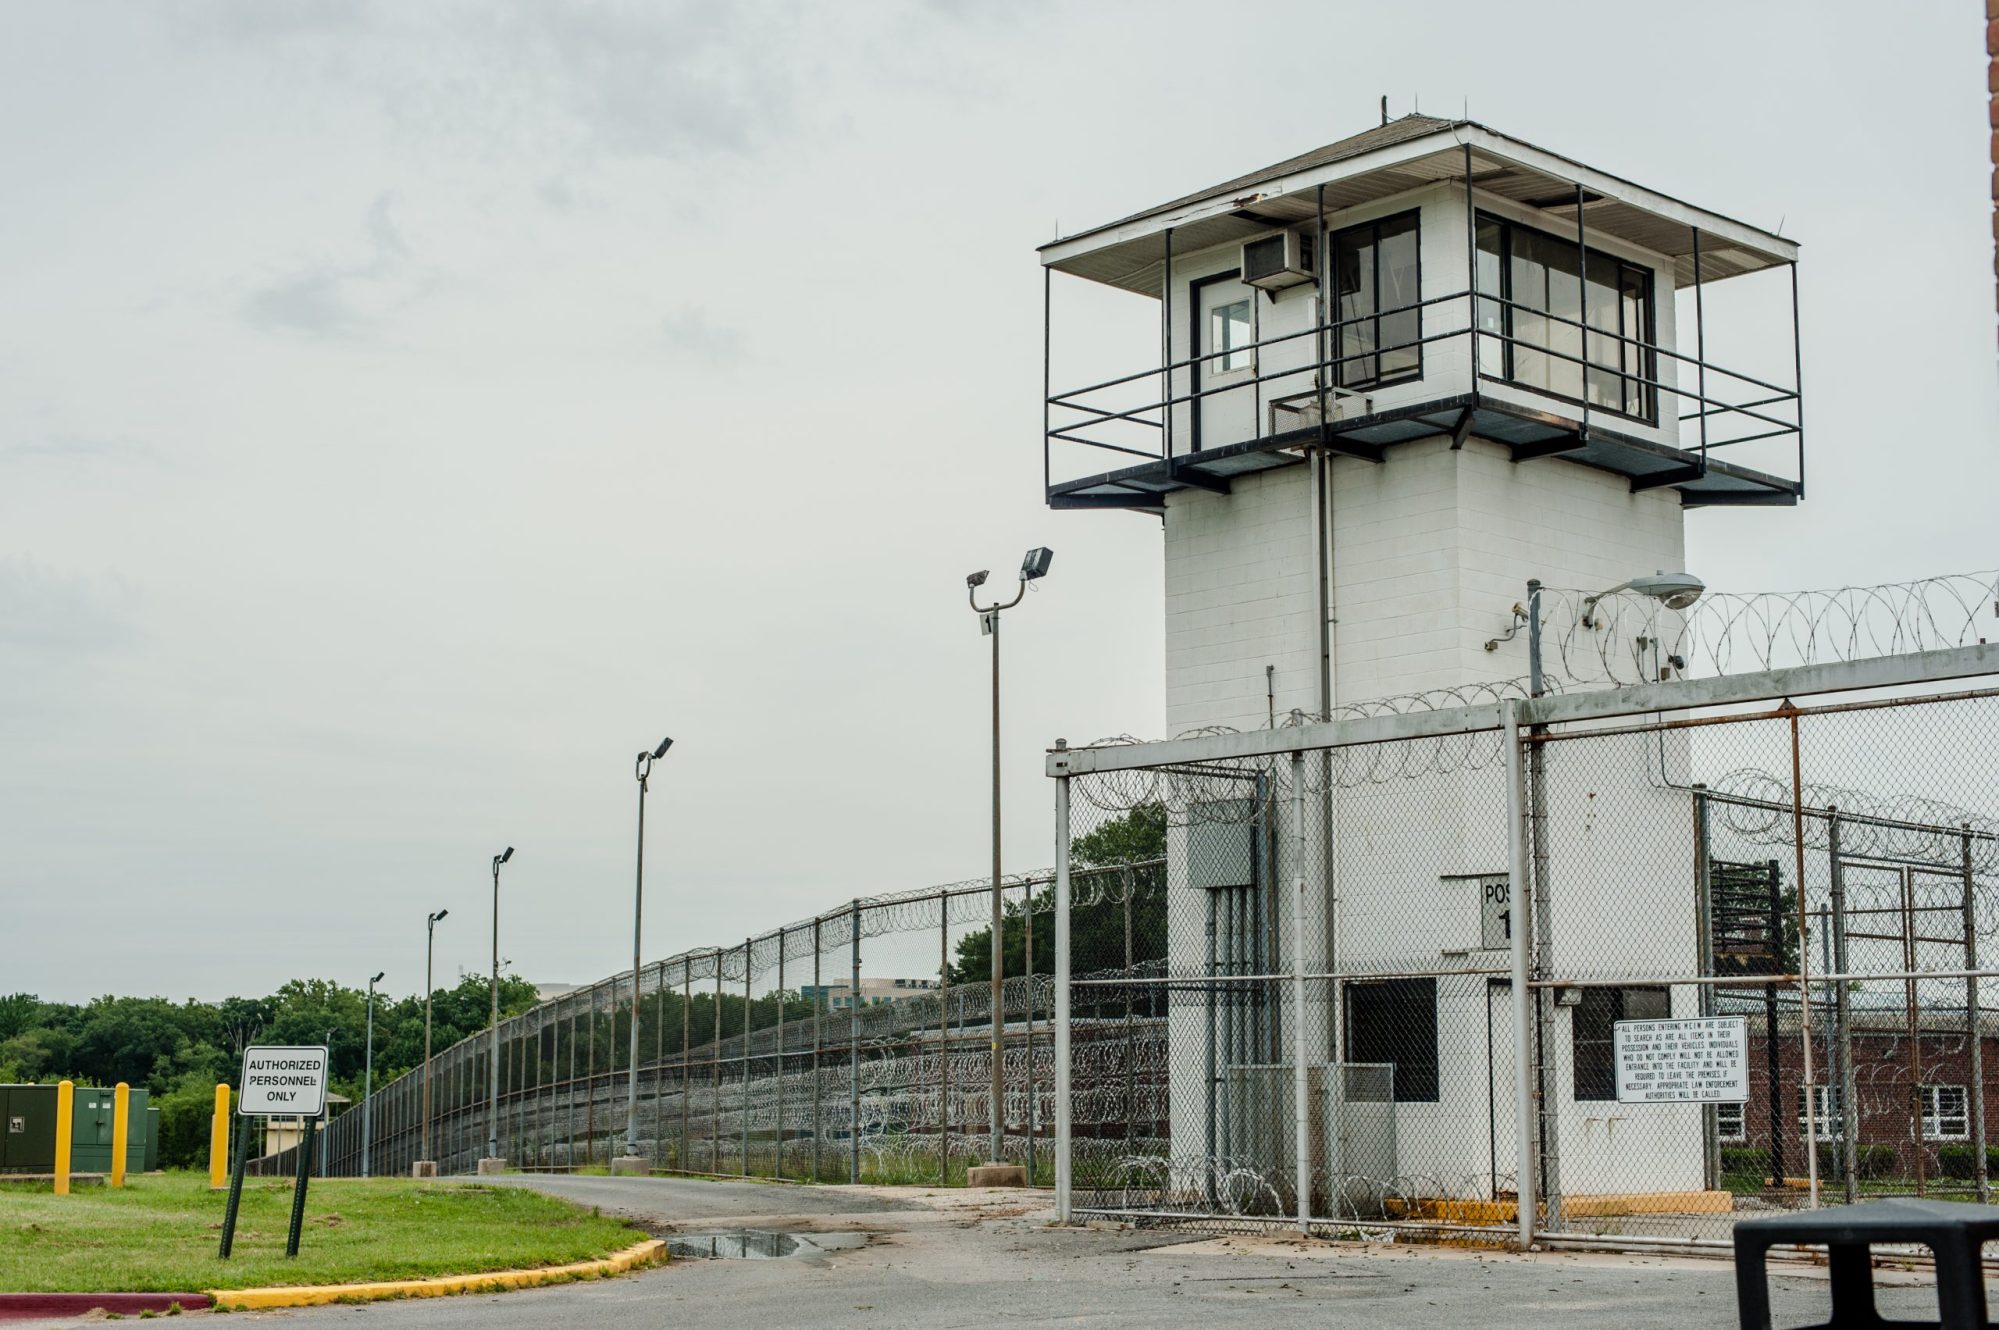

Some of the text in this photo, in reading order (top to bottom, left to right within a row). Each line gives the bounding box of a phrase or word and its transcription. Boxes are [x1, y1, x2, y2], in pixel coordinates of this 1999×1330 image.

[1499, 910, 1510, 938] 1
[249, 1061, 320, 1070] AUTHORIZED
[249, 1076, 316, 1086] PERSONNEL
[267, 1092, 296, 1101] ONLY
